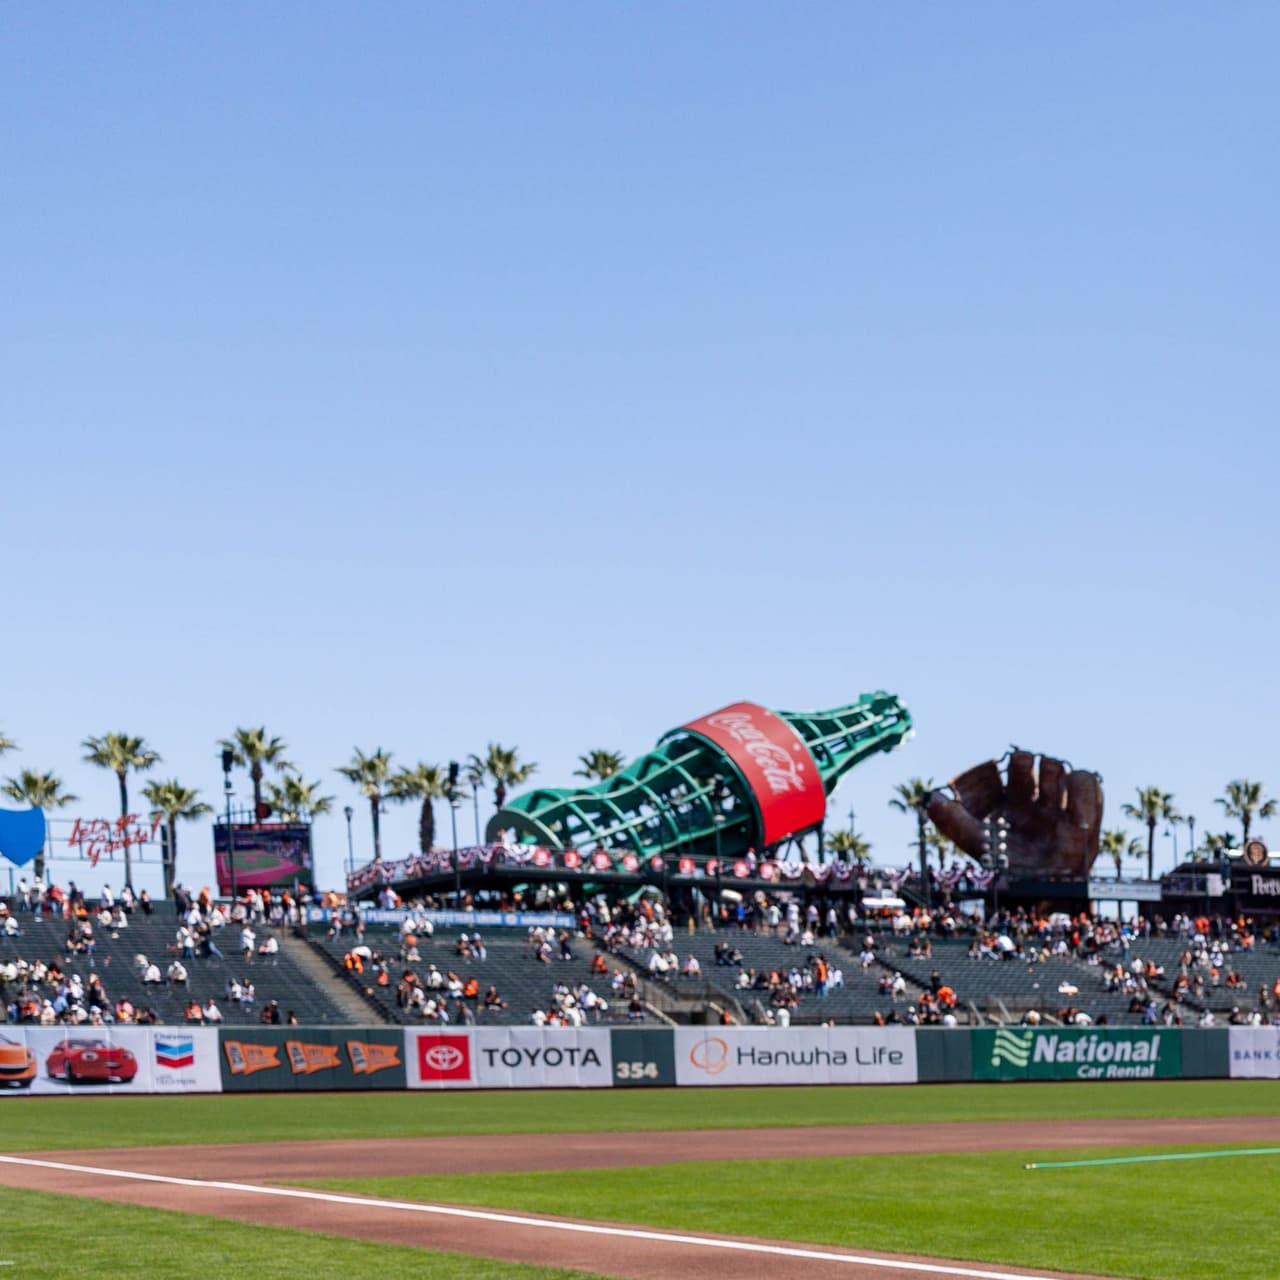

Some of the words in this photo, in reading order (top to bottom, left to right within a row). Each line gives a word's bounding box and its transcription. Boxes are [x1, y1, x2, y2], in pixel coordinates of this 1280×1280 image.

[482, 1047, 601, 1068] TOYOTA
[738, 1046, 847, 1066] Hanwha
[856, 1046, 903, 1066] Life
[1033, 1035, 1161, 1063] National
[1234, 1049, 1272, 1061] BANK
[617, 1062, 658, 1079] 354
[1077, 1065, 1106, 1078] Car
[1109, 1065, 1155, 1078] Rental
